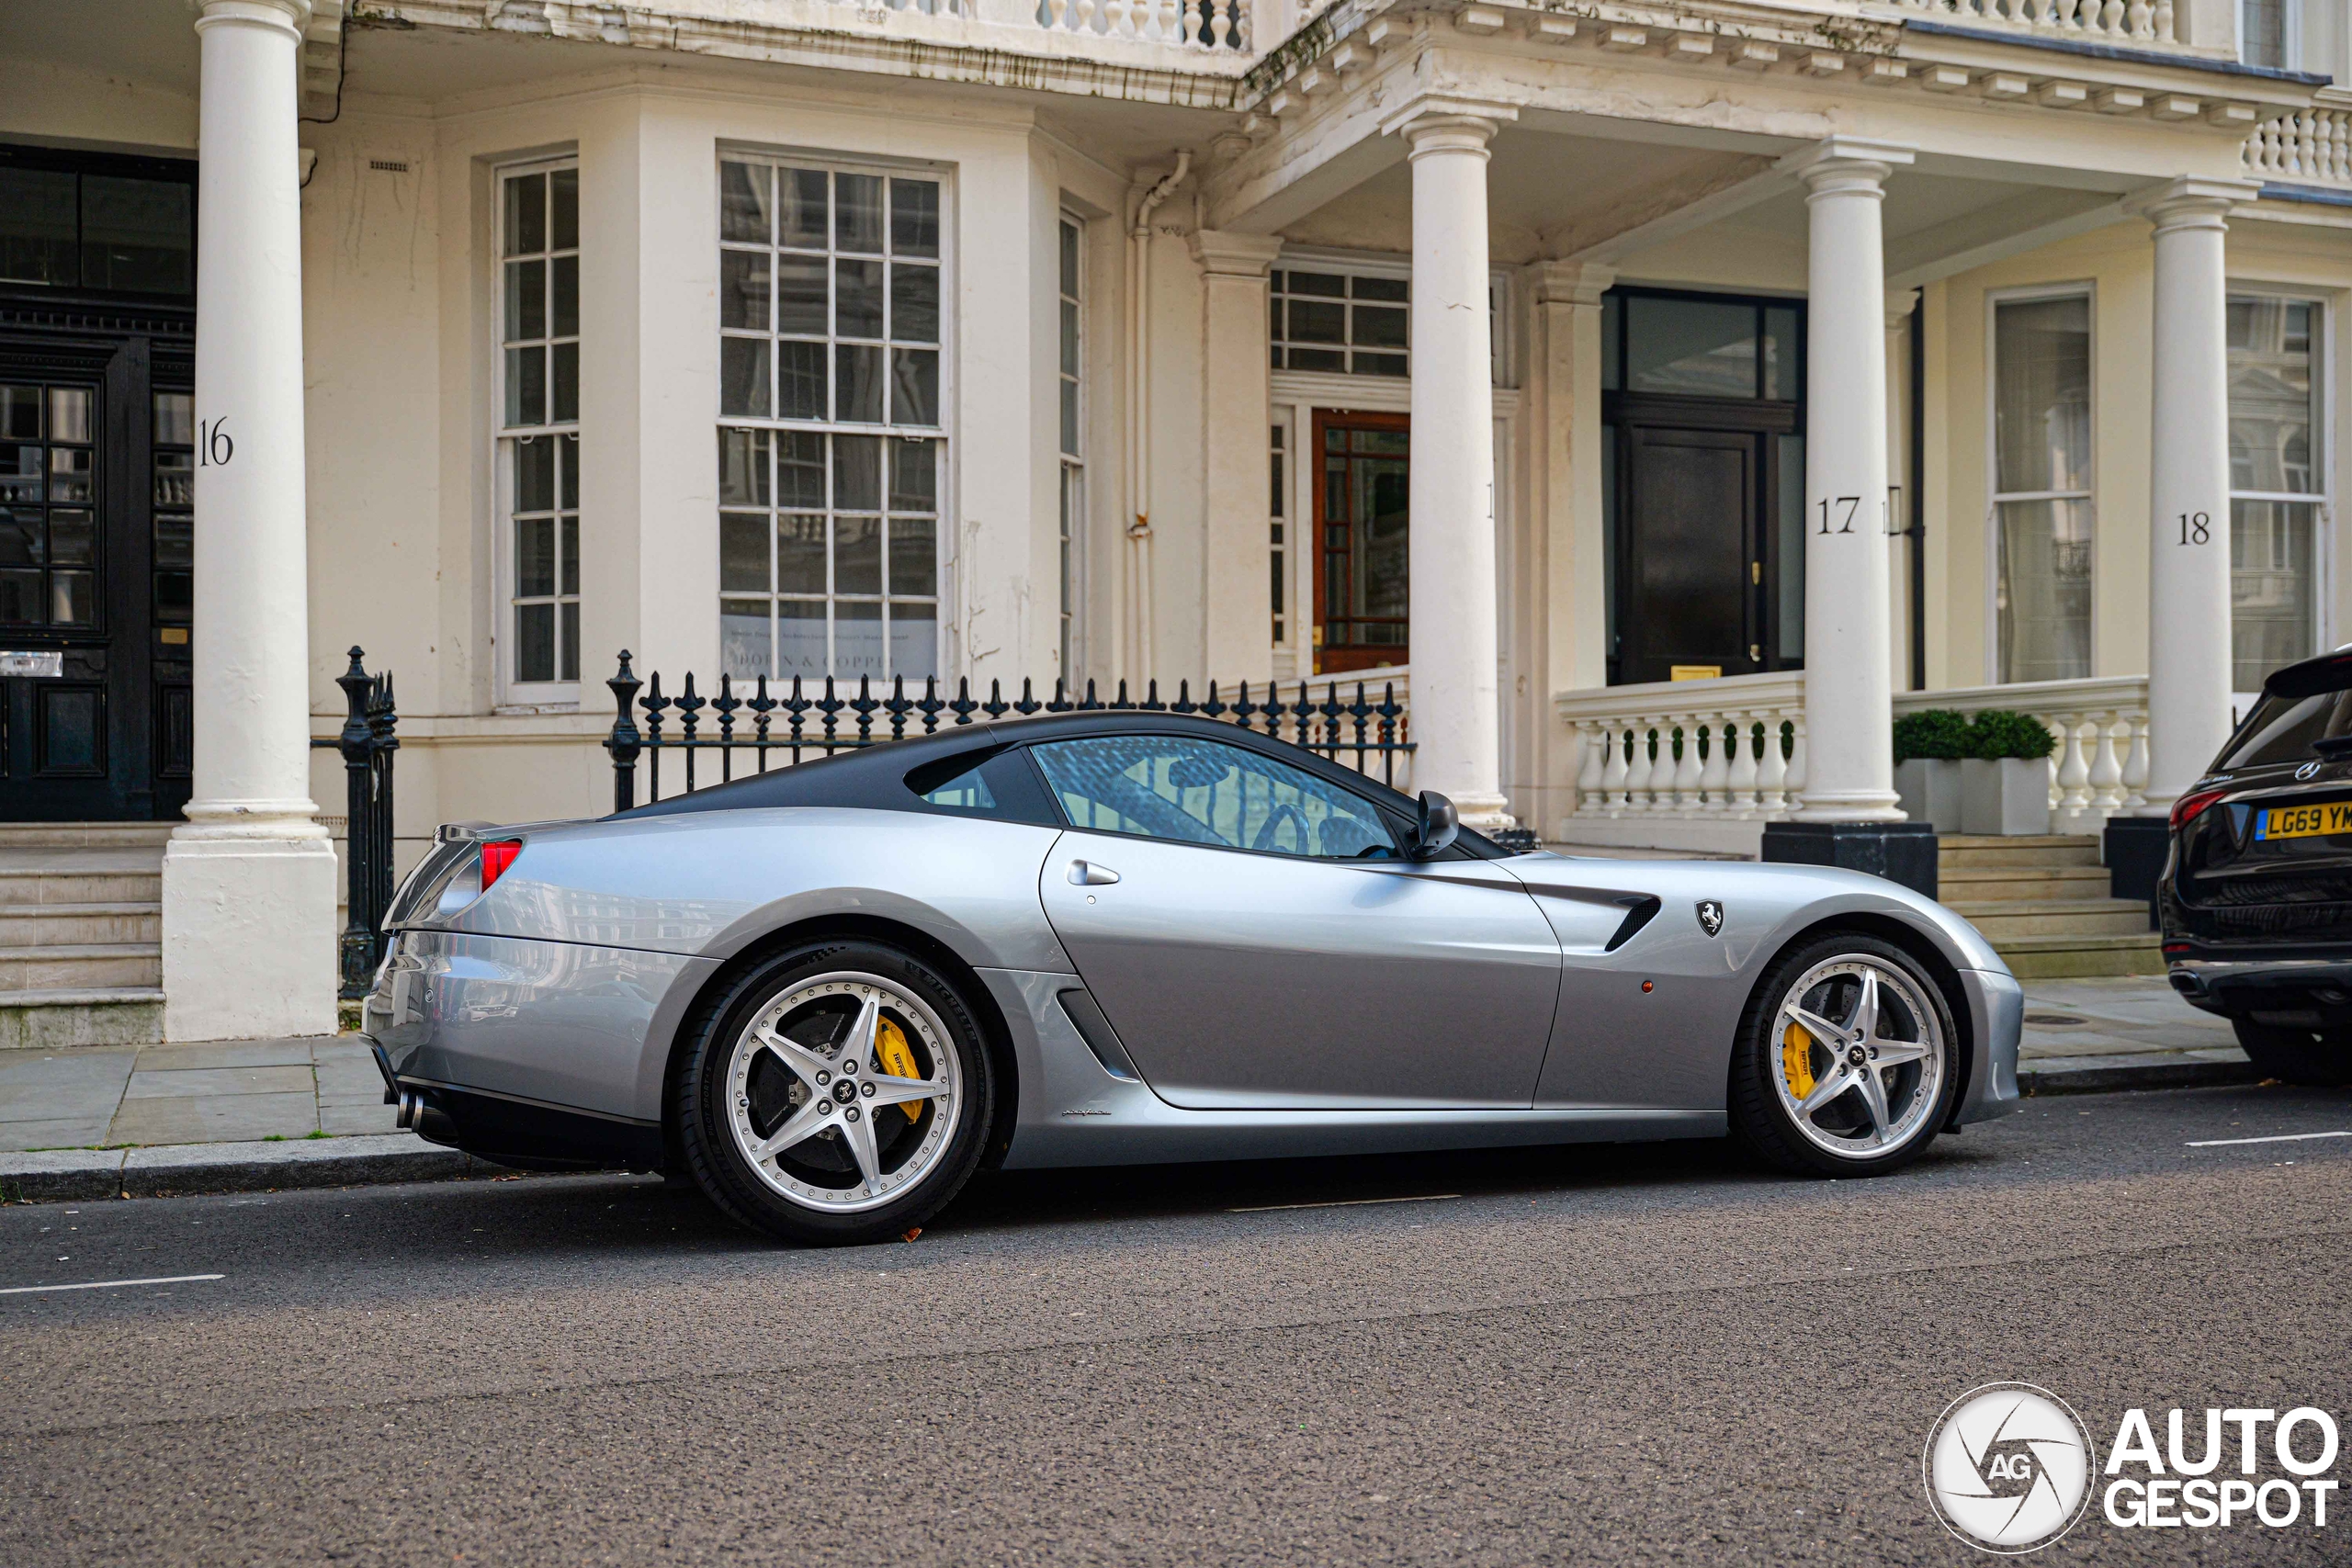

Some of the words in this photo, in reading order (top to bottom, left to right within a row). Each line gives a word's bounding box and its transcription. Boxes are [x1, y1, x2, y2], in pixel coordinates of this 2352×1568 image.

[199, 415, 234, 466] 16
[1816, 496, 1861, 536] 17
[2178, 512, 2210, 547] 18
[2268, 810, 2323, 834] LG69
